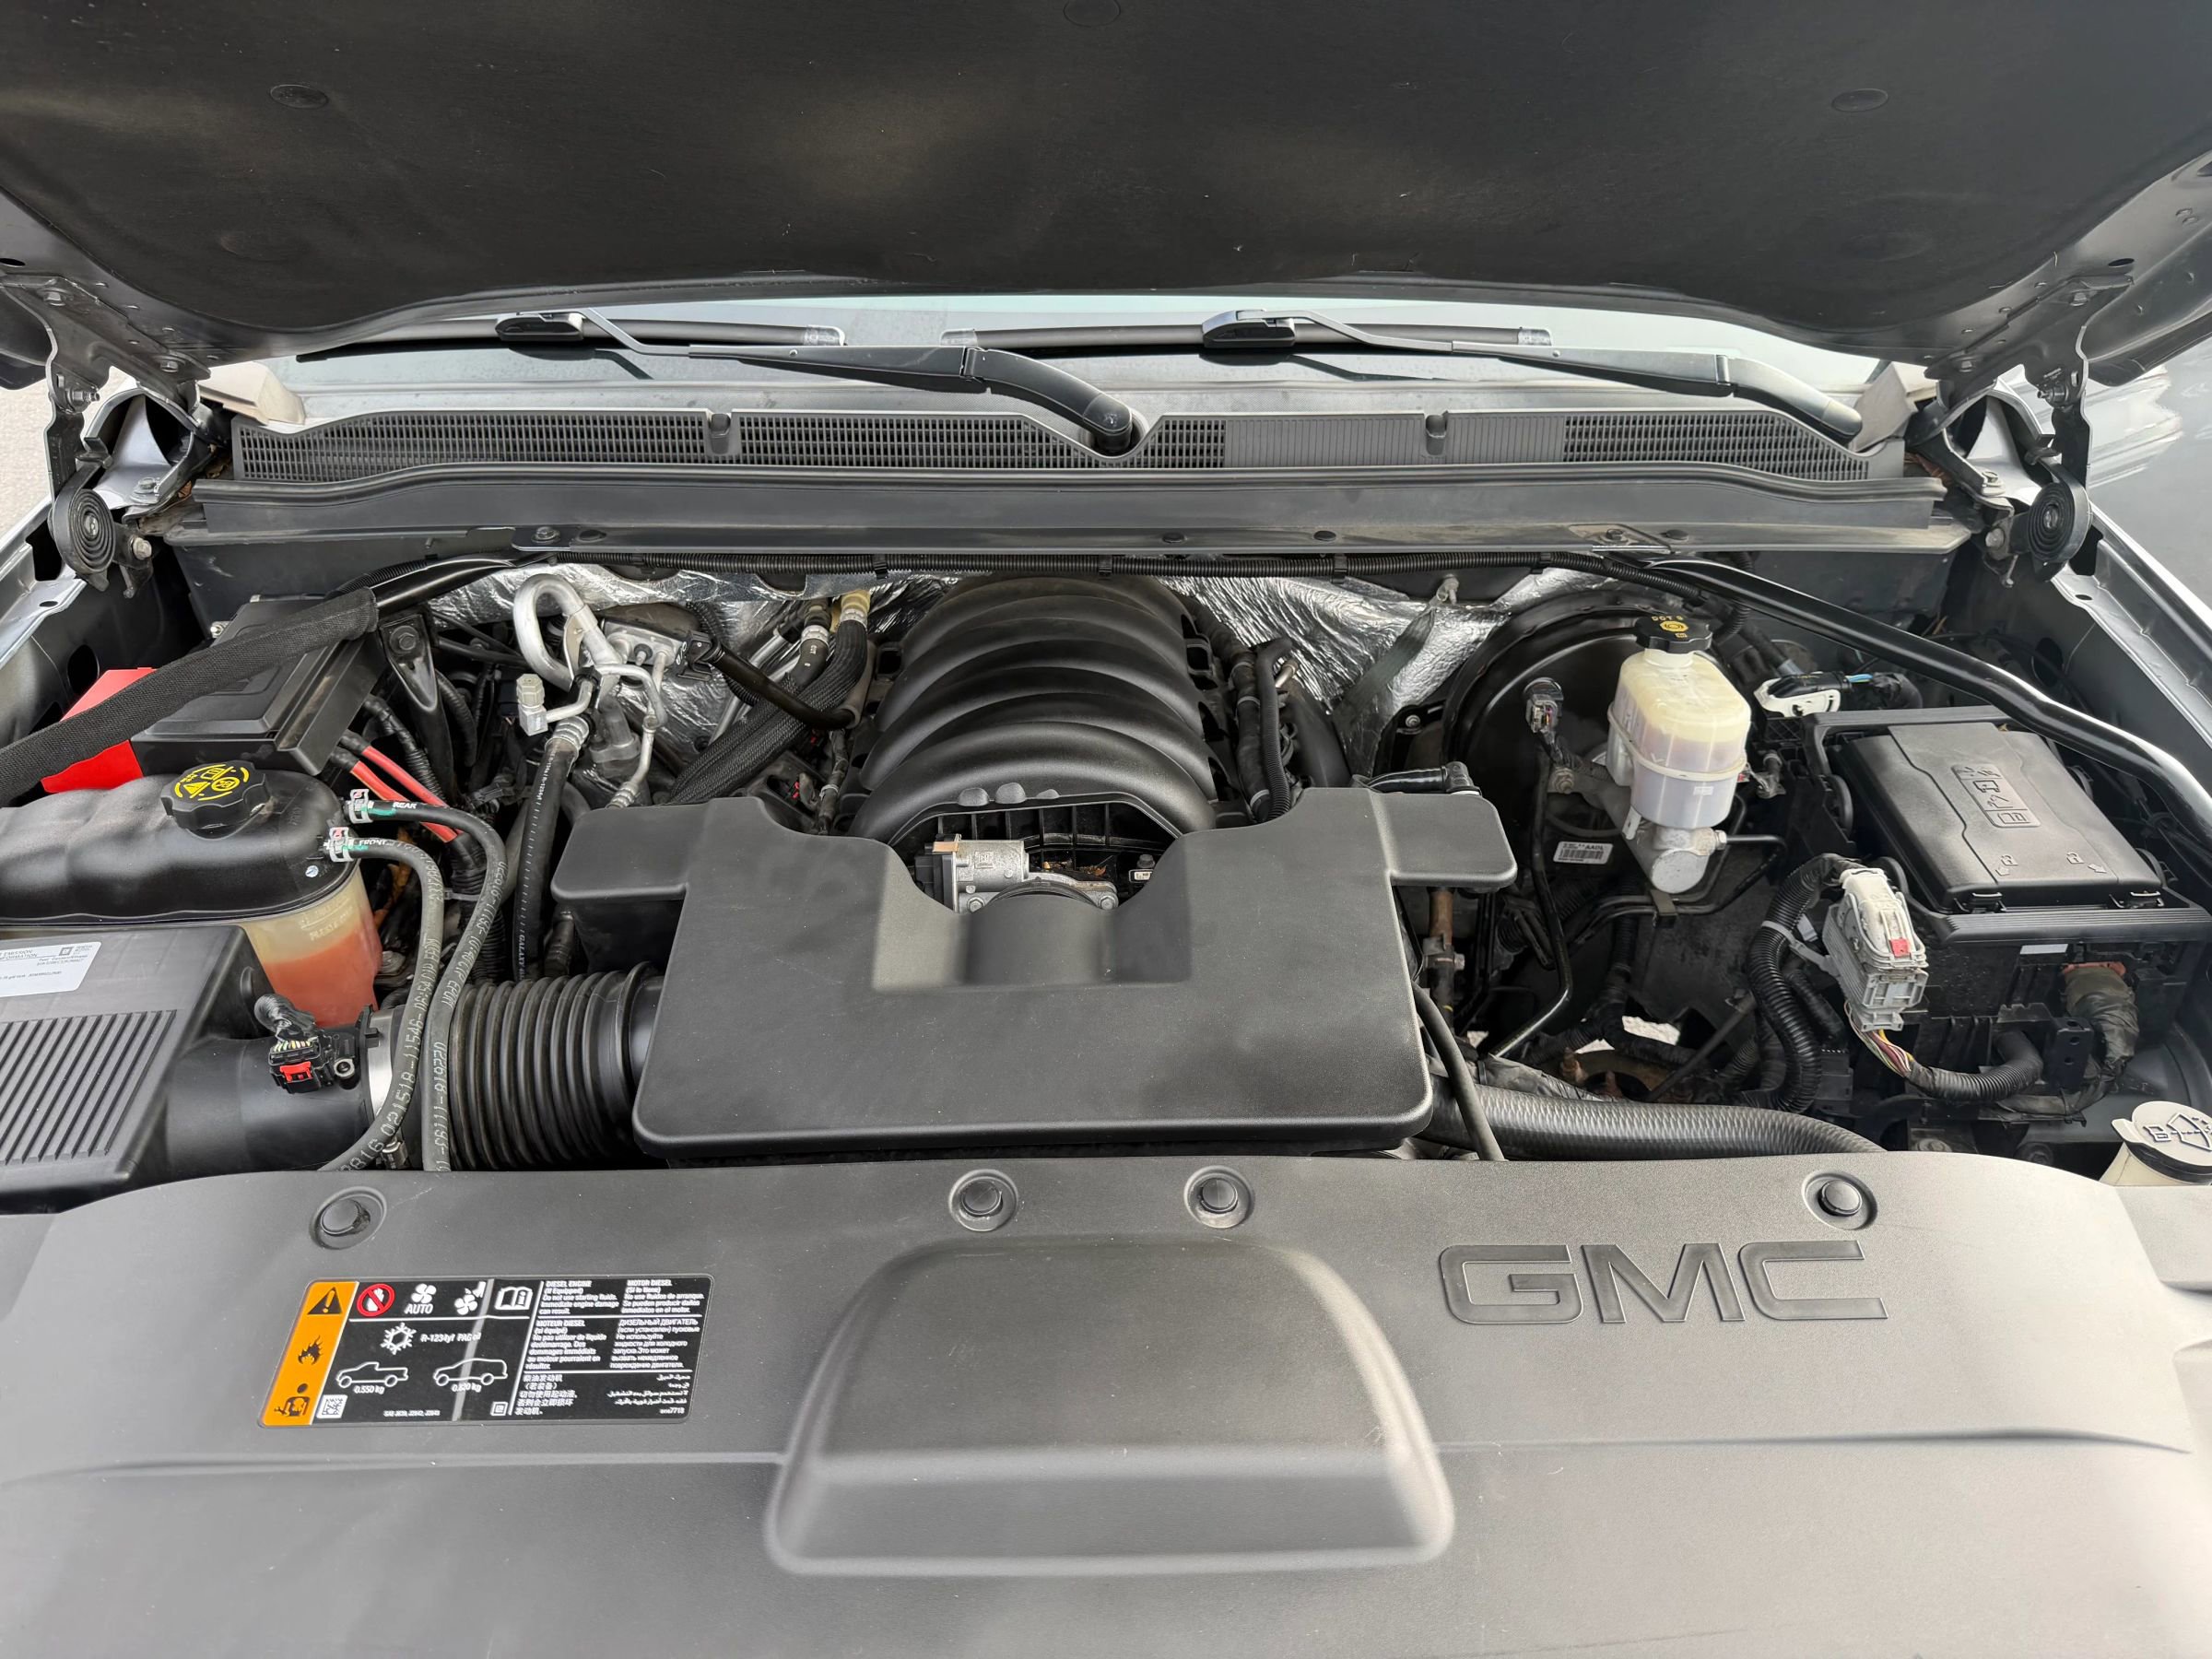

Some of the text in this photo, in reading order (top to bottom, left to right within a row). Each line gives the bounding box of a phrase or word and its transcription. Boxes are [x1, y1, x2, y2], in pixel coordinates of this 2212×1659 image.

[392, 801, 417, 809] REAR
[359, 839, 385, 847] FRONT
[1440, 1240, 1888, 1324] GMC
[404, 1303, 433, 1314] AUTO
[375, 1385, 385, 1395] kg
